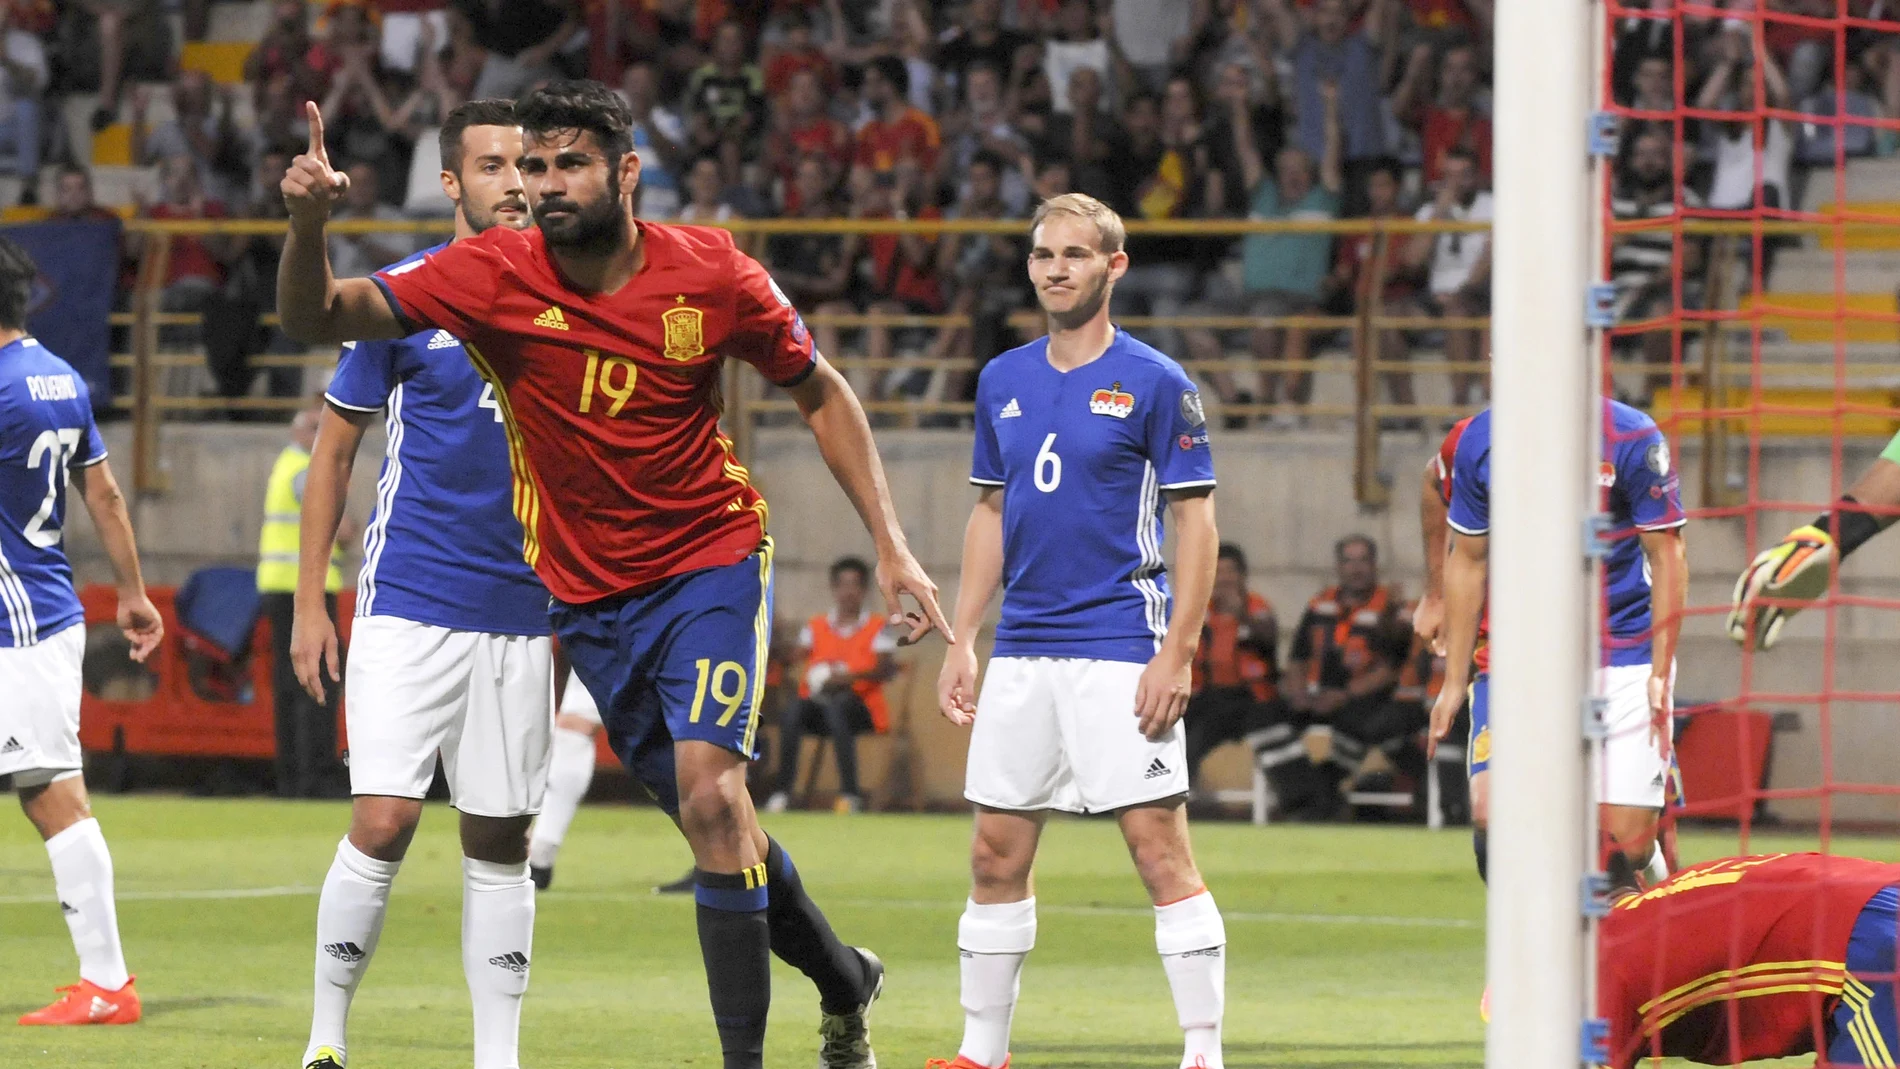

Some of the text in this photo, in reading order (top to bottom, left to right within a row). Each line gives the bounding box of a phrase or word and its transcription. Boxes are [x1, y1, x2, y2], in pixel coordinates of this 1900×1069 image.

[478, 382, 504, 423] 4
[577, 351, 638, 418] 19
[23, 427, 83, 549] 27
[1033, 432, 1062, 493] 6
[688, 658, 747, 728] 19
